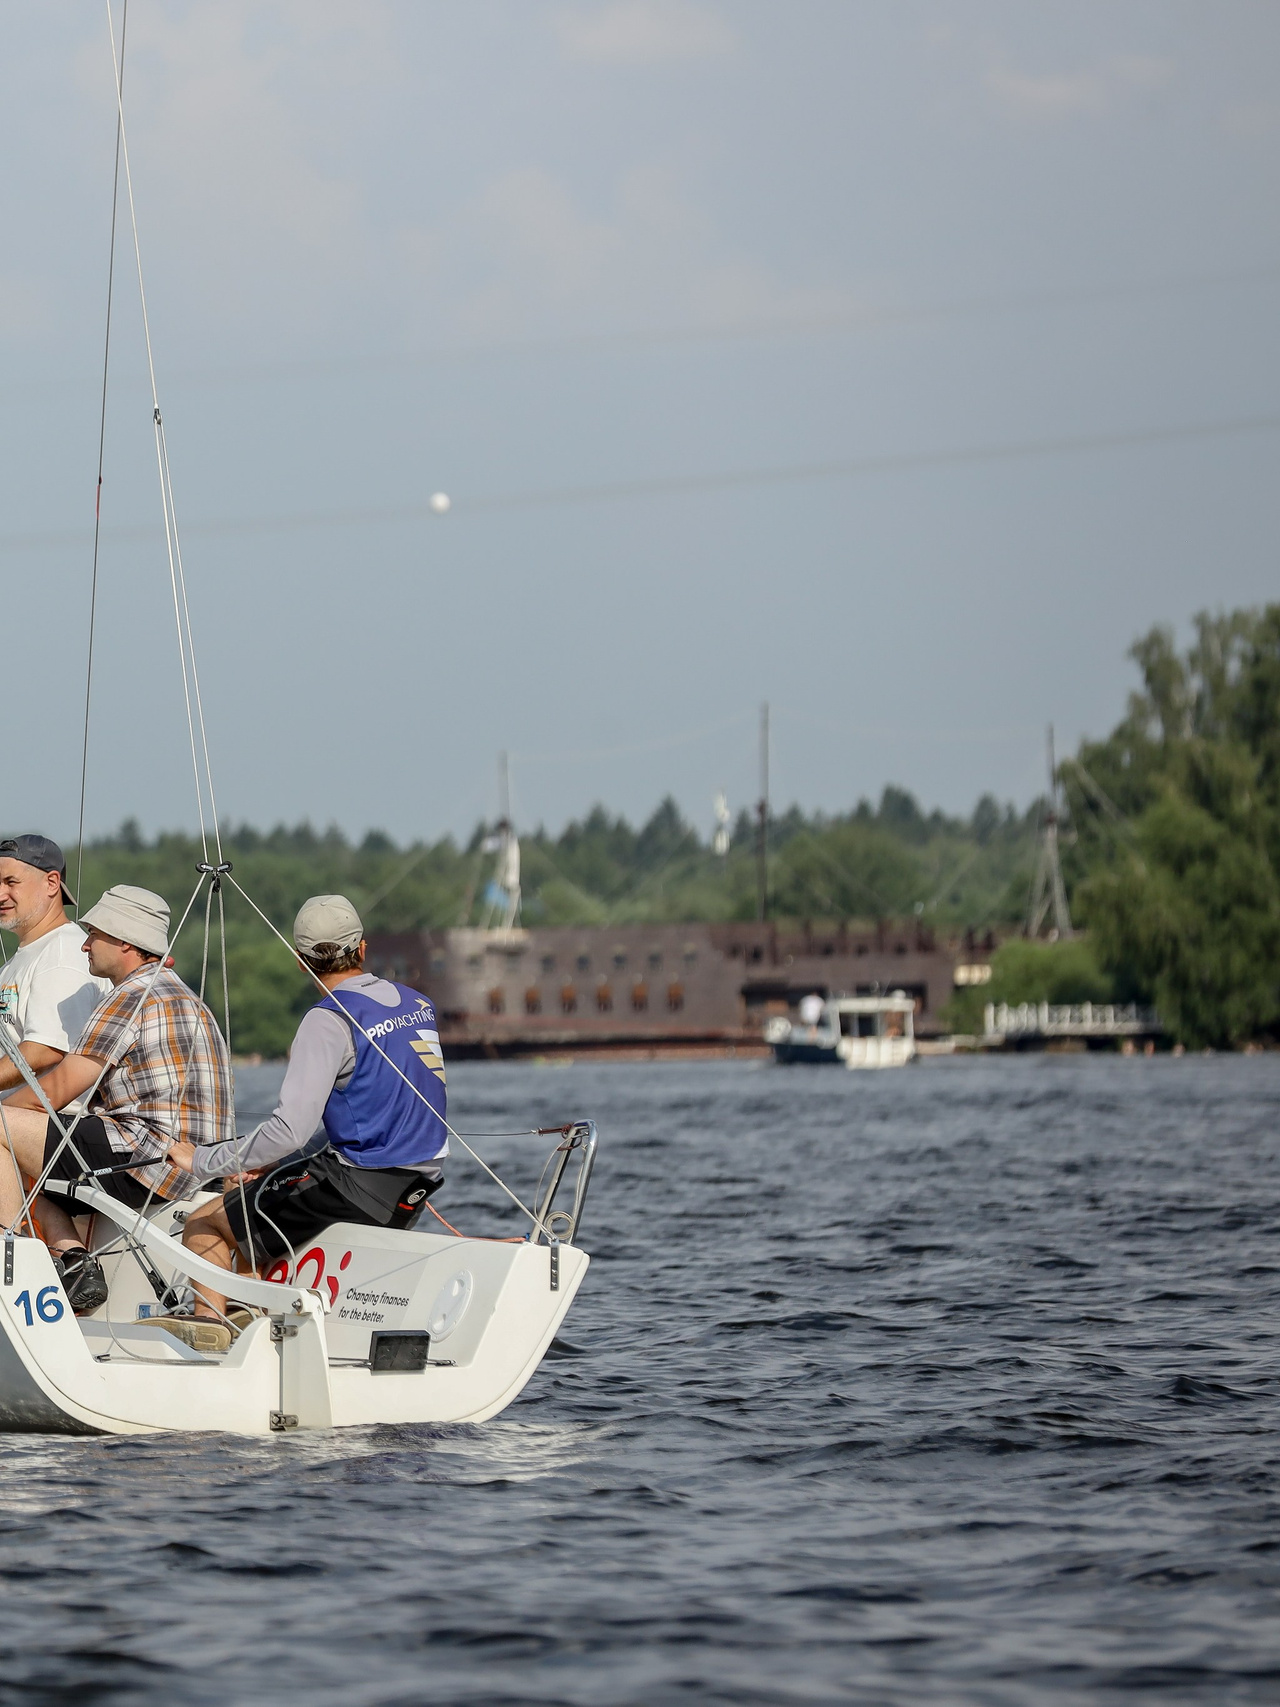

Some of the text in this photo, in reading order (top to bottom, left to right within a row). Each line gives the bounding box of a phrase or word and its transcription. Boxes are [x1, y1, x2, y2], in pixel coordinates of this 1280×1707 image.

[366, 1008, 435, 1041] PROYACHTING
[14, 1285, 64, 1327] 16
[346, 1287, 410, 1307] Changing finances
[338, 1306, 385, 1324] for the better.
